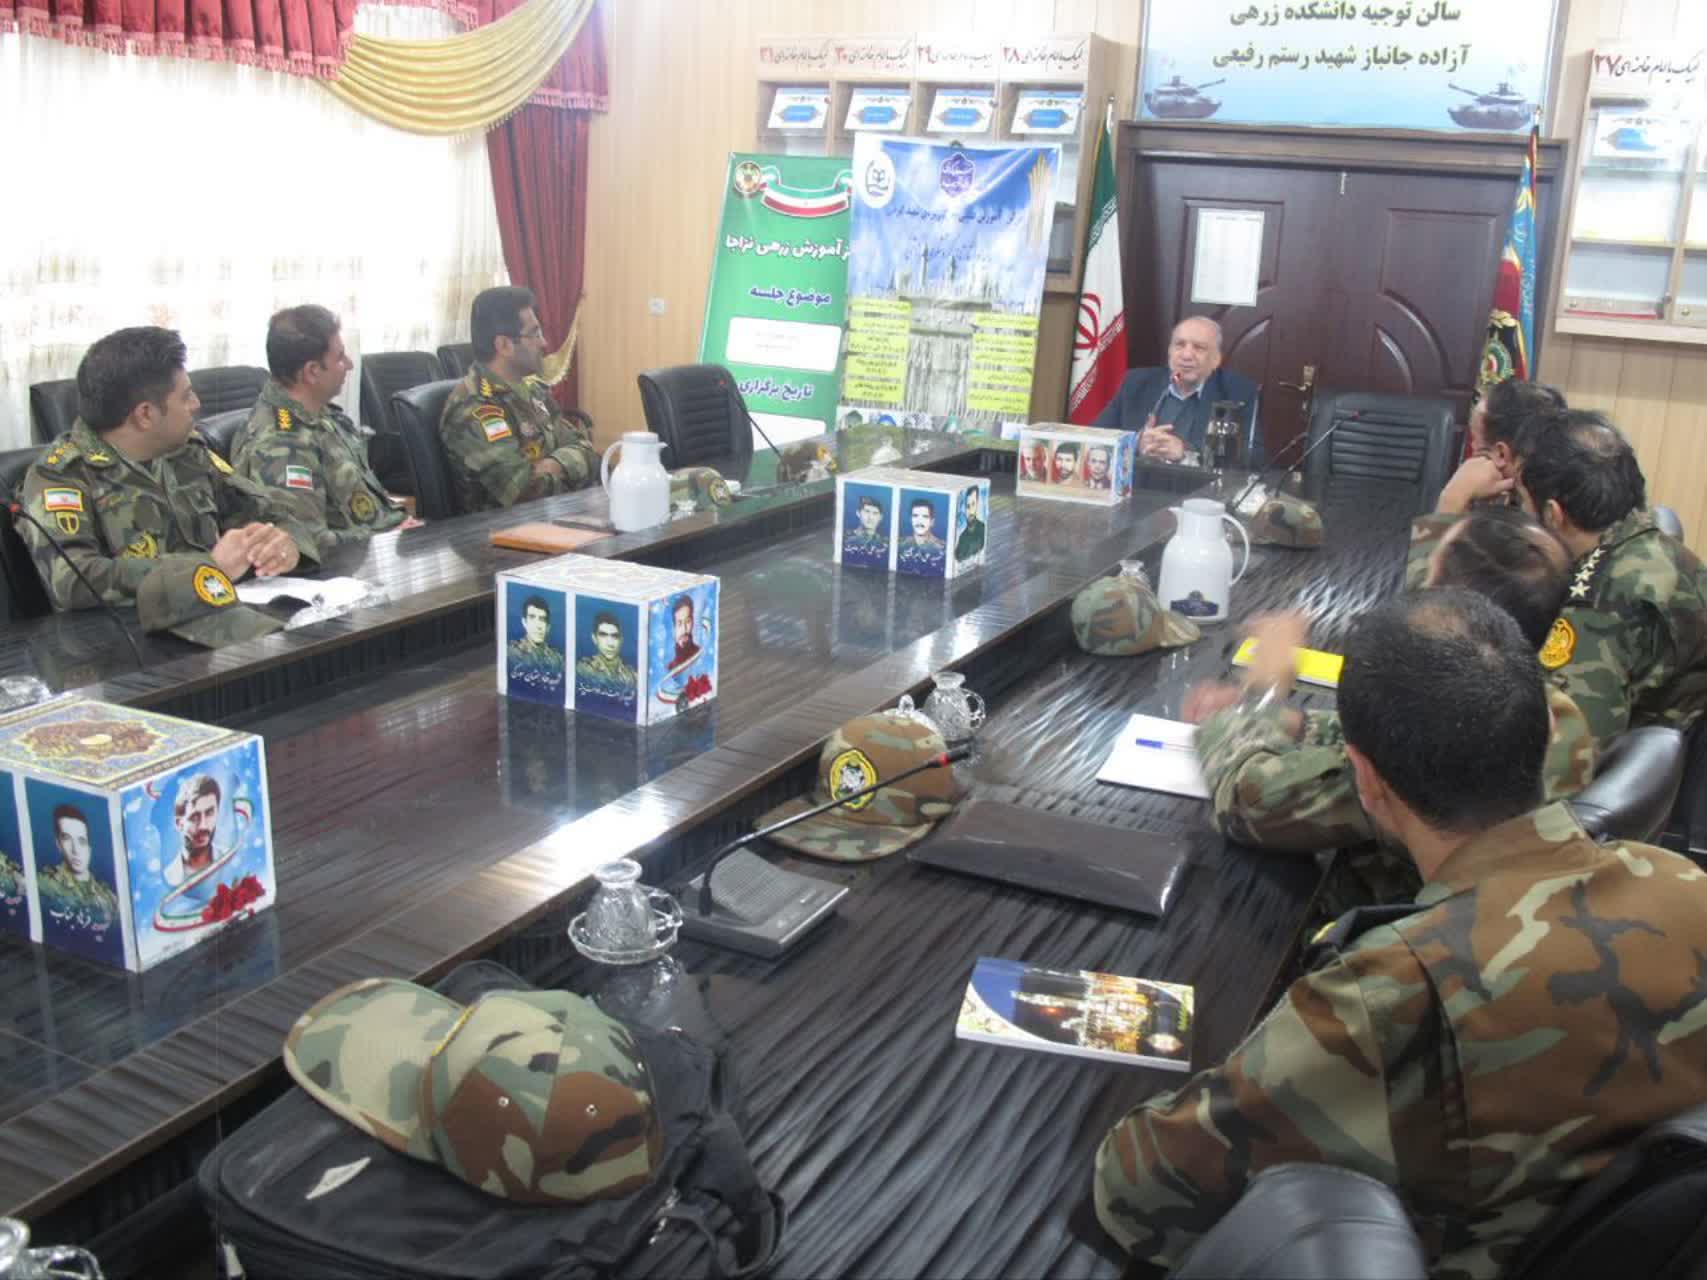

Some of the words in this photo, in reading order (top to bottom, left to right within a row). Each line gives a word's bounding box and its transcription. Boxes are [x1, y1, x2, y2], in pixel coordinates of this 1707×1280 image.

[1229, 4, 1280, 26] زرهی
[1284, 0, 1357, 21] دانشکده
[1361, 1, 1411, 27] توجیه
[1416, 0, 1461, 27] سالن
[1212, 42, 1264, 69] رفیعی
[1268, 46, 1310, 69] رستم
[1314, 44, 1357, 69] شهید
[1361, 45, 1413, 71] جانباز
[1418, 44, 1472, 73] آزاده
[725, 234, 755, 253] نزاجا
[755, 240, 790, 256] زرهی
[792, 239, 844, 259] آموزش
[749, 285, 784, 303] جلسه
[786, 288, 832, 308] موضوع
[738, 377, 780, 397] برگزاری
[781, 383, 815, 401] تاریخ
